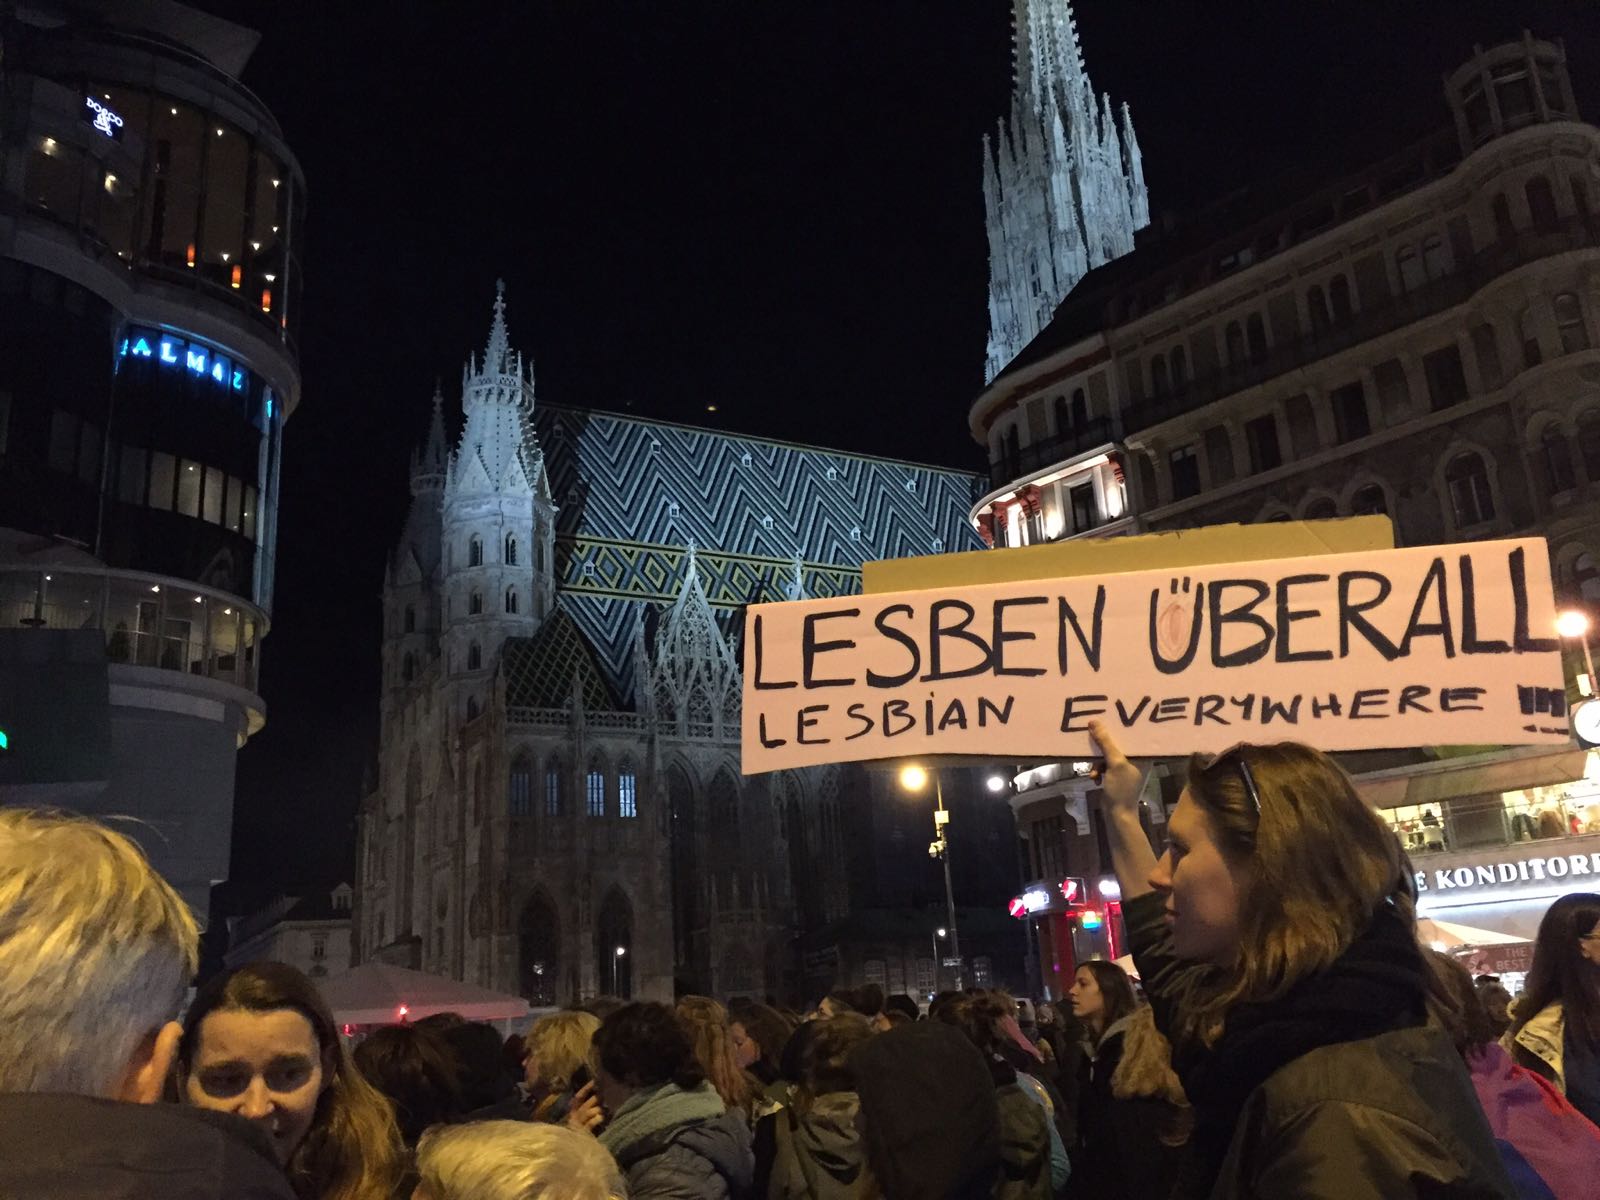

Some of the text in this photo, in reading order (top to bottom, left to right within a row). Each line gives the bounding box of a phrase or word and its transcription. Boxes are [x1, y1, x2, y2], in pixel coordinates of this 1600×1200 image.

[754, 546, 1561, 689] LESBEN ÜBERALL
[1061, 685, 1487, 733] EVERYWHERE
[1496, 959, 1527, 971] BEST
[1504, 947, 1529, 957] THE
